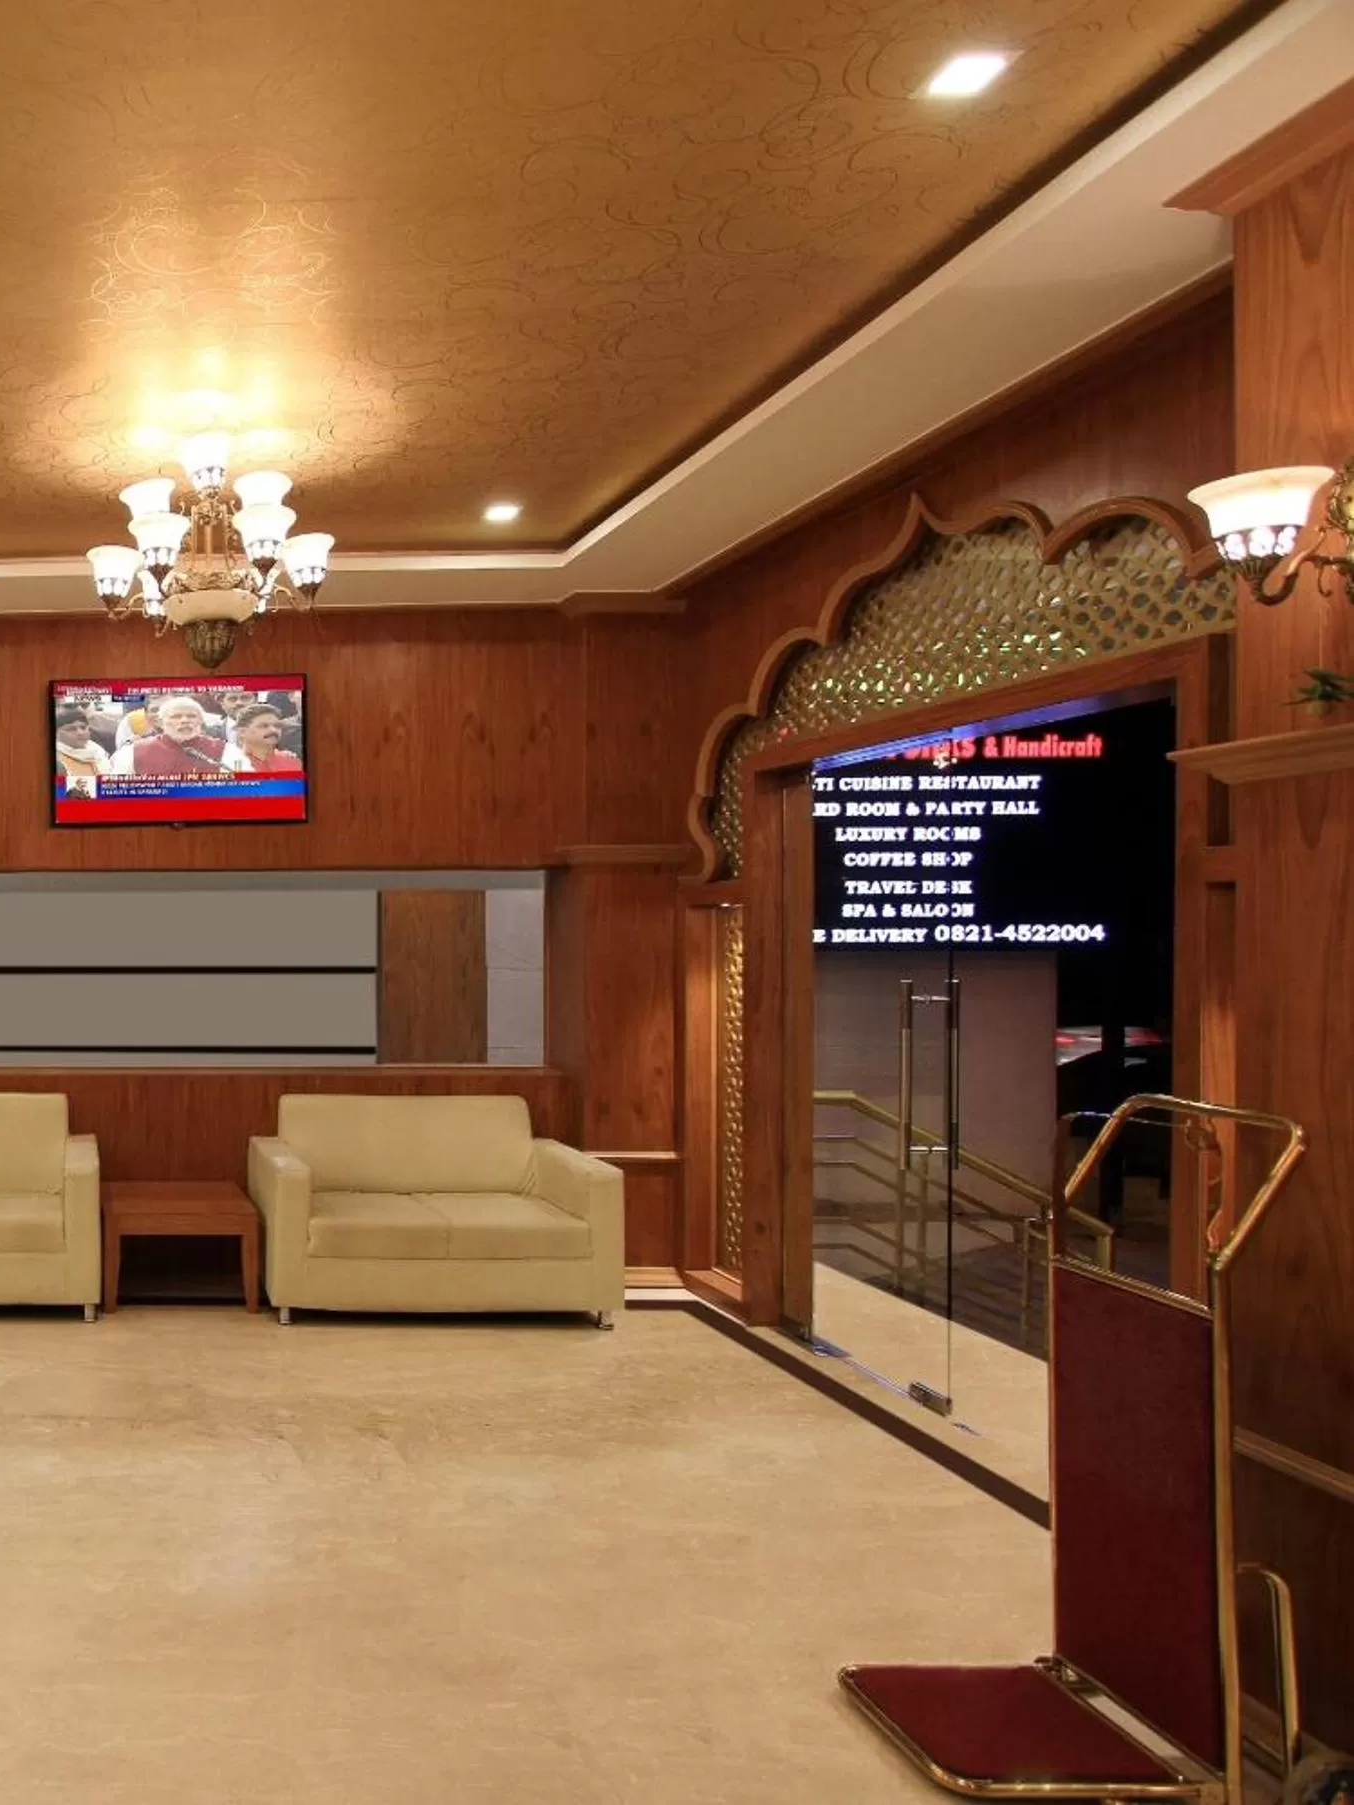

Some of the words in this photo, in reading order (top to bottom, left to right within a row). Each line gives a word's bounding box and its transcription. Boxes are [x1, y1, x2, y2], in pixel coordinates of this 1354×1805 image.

[983, 735, 999, 758] &
[1002, 733, 1102, 758] Handicraft
[812, 778, 834, 791] TI
[839, 776, 913, 791] CUISINE
[918, 775, 1041, 790] RESTAURANT
[812, 802, 841, 816] RD
[846, 802, 901, 816] ROOM
[905, 801, 921, 816] &
[925, 801, 986, 816] PARTY
[992, 800, 1040, 815] HALL
[835, 827, 908, 842] LUXURY
[913, 827, 982, 842] ROOMS
[843, 852, 916, 867] COFFEE
[844, 880, 918, 895] TRAVEL
[842, 903, 878, 918] SPA
[882, 903, 897, 918] &
[831, 928, 928, 943] DELIVERY
[934, 924, 1106, 942] 0821-4522004
